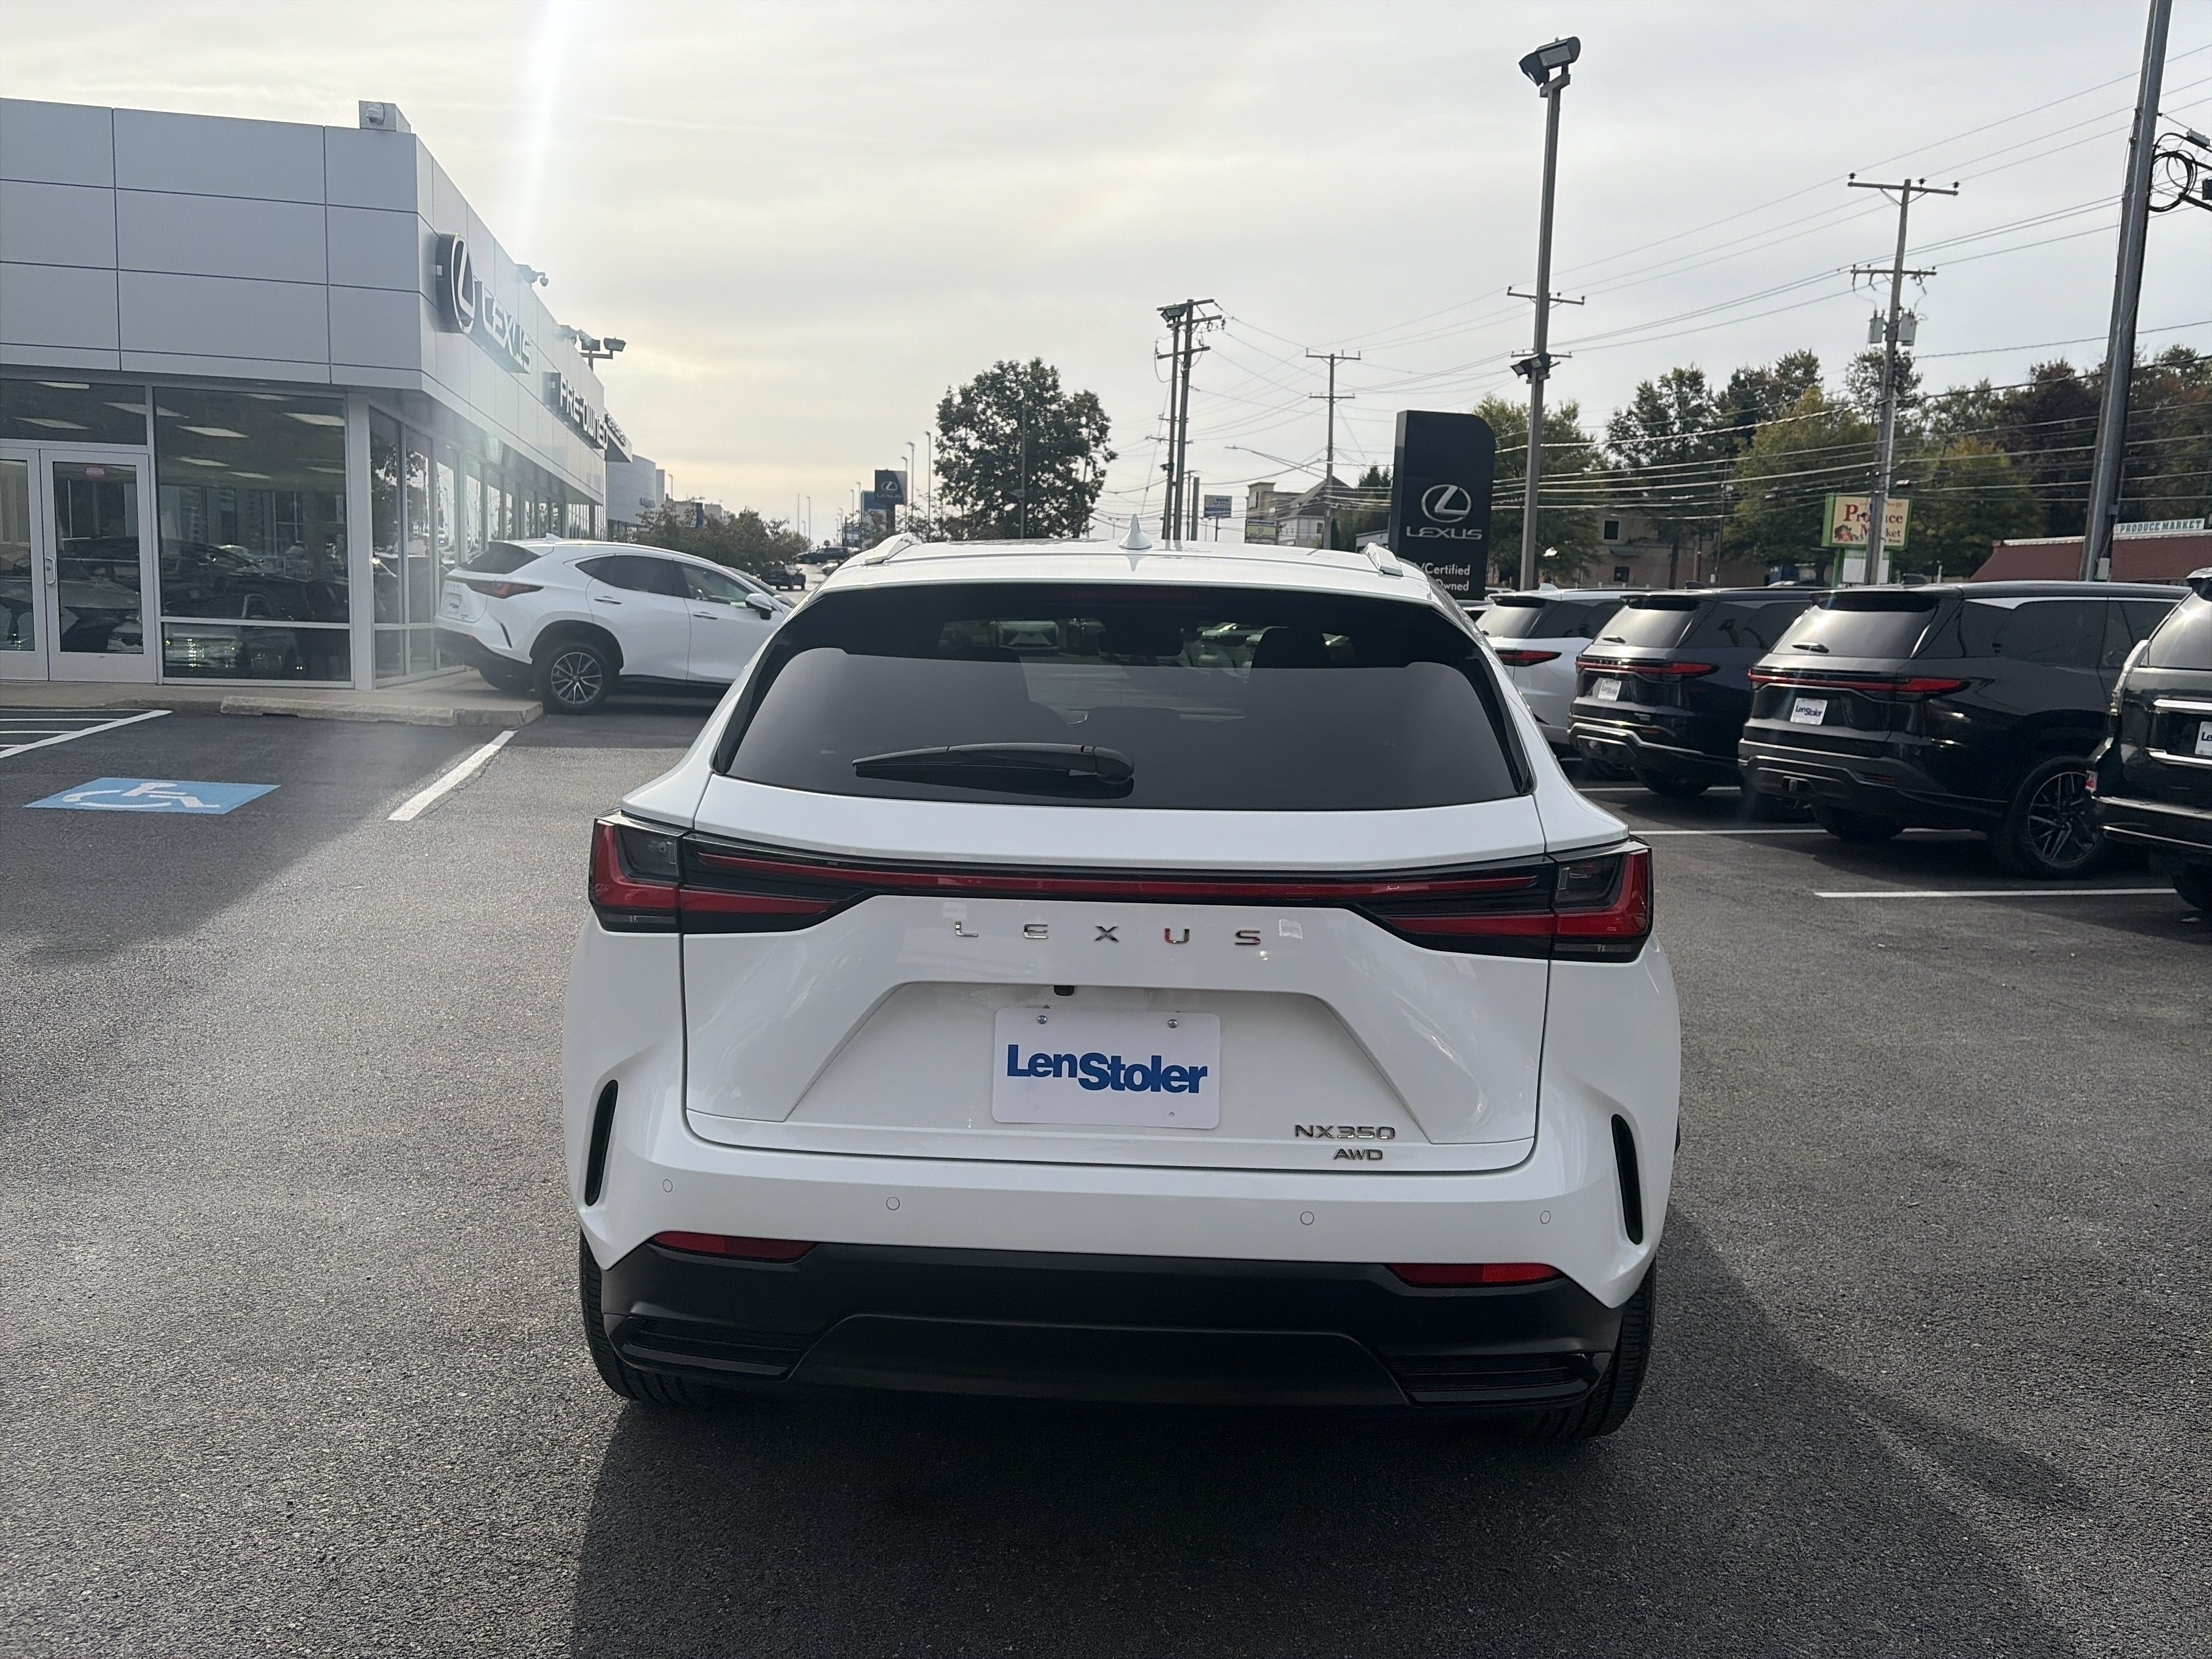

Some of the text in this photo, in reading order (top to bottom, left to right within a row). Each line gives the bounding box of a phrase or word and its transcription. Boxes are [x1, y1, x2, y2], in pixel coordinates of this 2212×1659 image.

[482, 284, 531, 374] LEXUS
[1844, 504, 1903, 524] Prce
[1406, 526, 1483, 540] LEXUS
[2120, 520, 2202, 533] PRODUCE MARKET
[1795, 705, 1822, 717] LenStoler
[955, 921, 1261, 946] LEXUS
[1007, 1044, 1208, 1093] LenStoler
[1295, 1124, 1396, 1139] NX350
[1333, 1148, 1383, 1160] AWD
